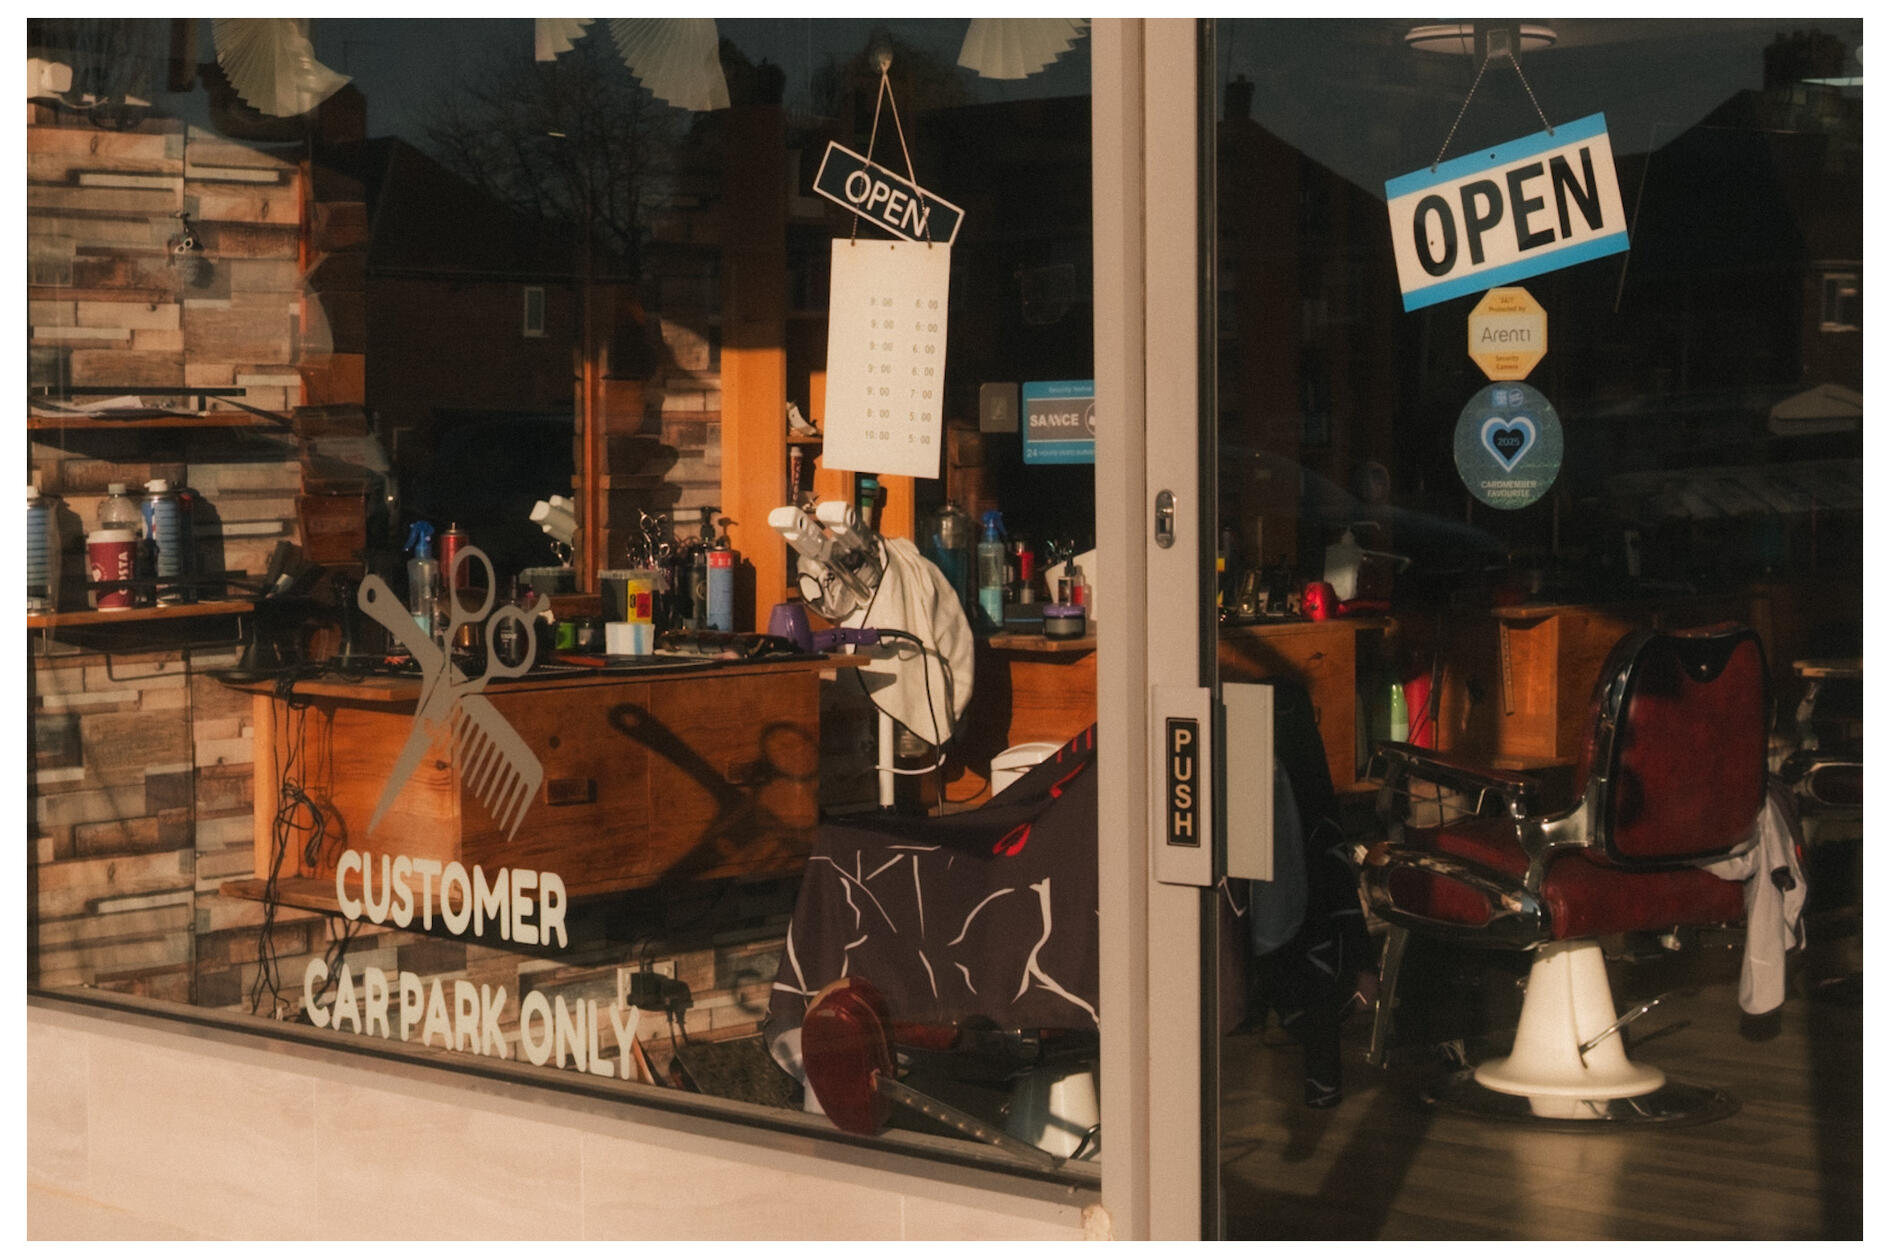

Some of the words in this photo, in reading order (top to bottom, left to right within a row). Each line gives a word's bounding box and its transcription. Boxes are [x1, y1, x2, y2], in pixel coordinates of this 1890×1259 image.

[845, 170, 931, 237] OPEN
[1413, 146, 1604, 277] OPEN
[1481, 327, 1531, 343] Arenti
[1026, 449, 1037, 458] 24
[1174, 729, 1192, 837] PUSH
[336, 849, 568, 948] CUSTOMER
[304, 957, 390, 1040] CAR
[400, 971, 508, 1060] PARK
[520, 990, 640, 1080] ONLY
